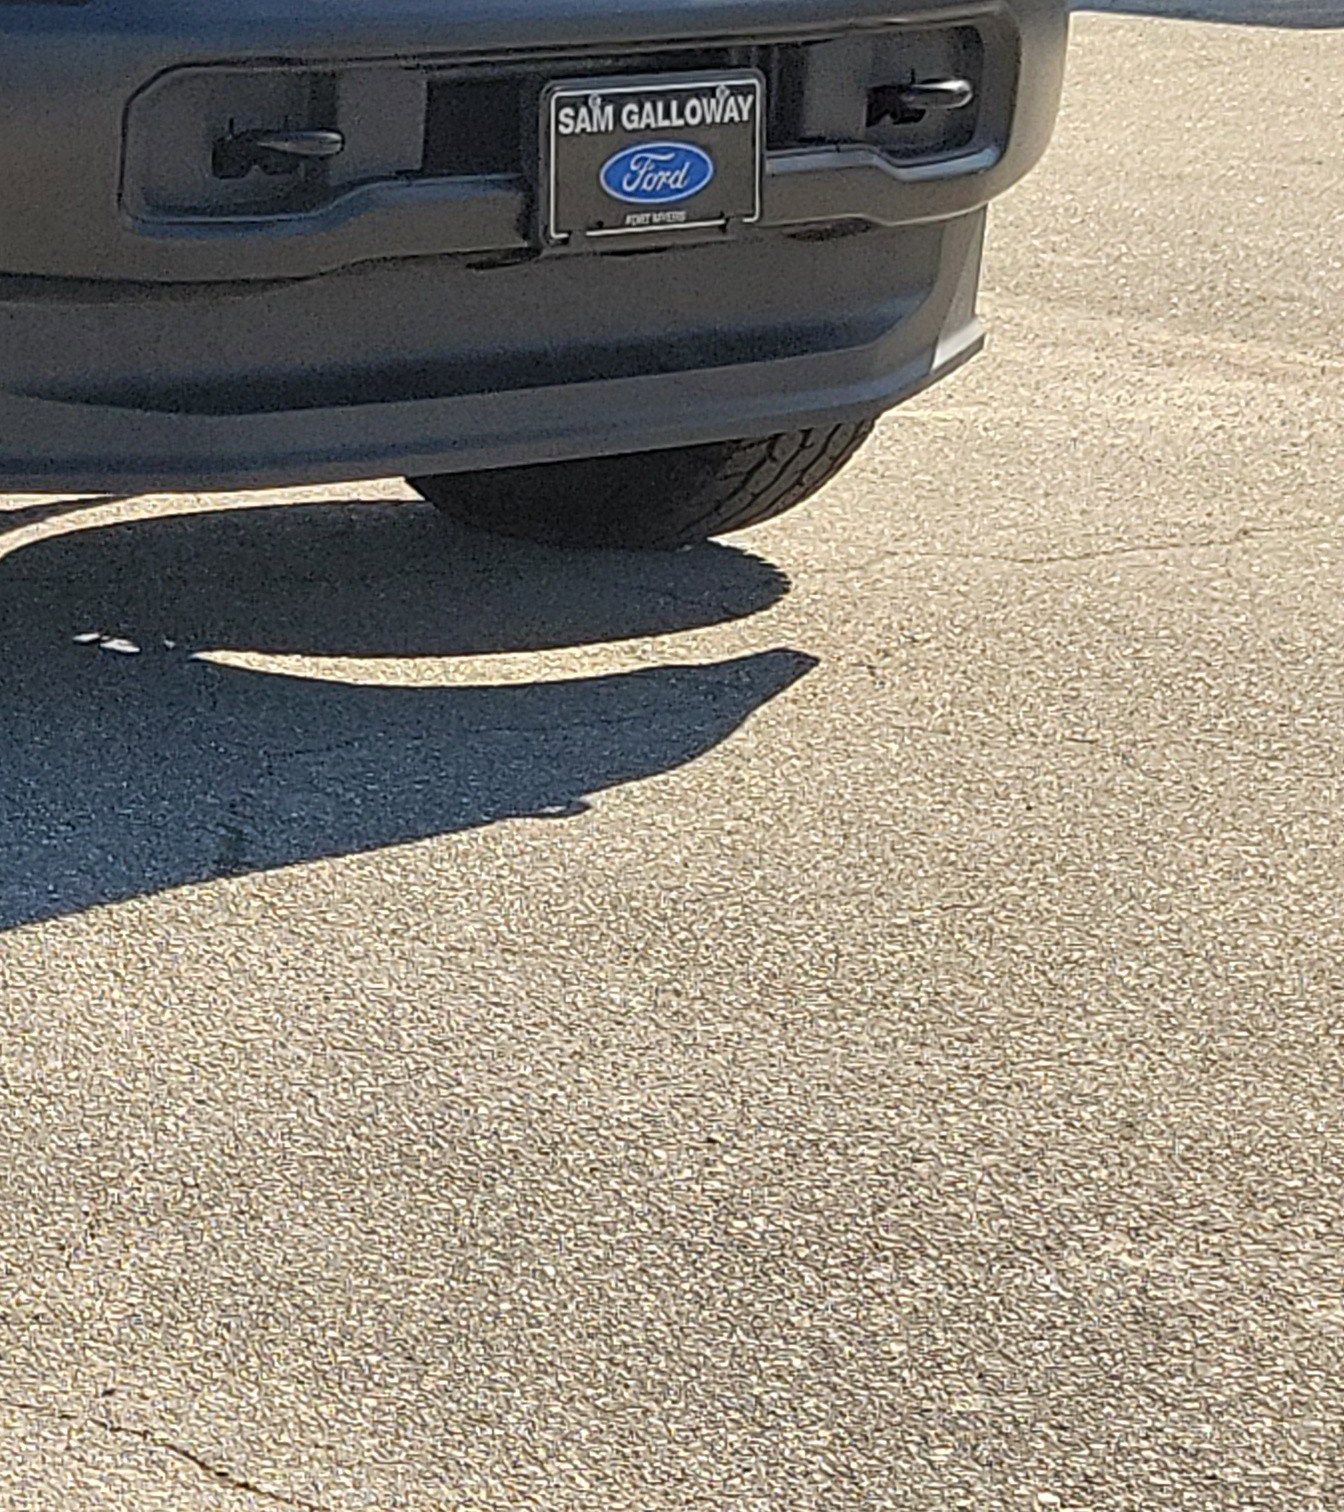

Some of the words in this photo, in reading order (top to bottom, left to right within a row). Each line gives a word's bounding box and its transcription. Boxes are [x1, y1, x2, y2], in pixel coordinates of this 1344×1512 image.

[558, 103, 614, 135] SAM
[621, 93, 754, 130] GALLOWAY
[622, 152, 689, 192] Ford
